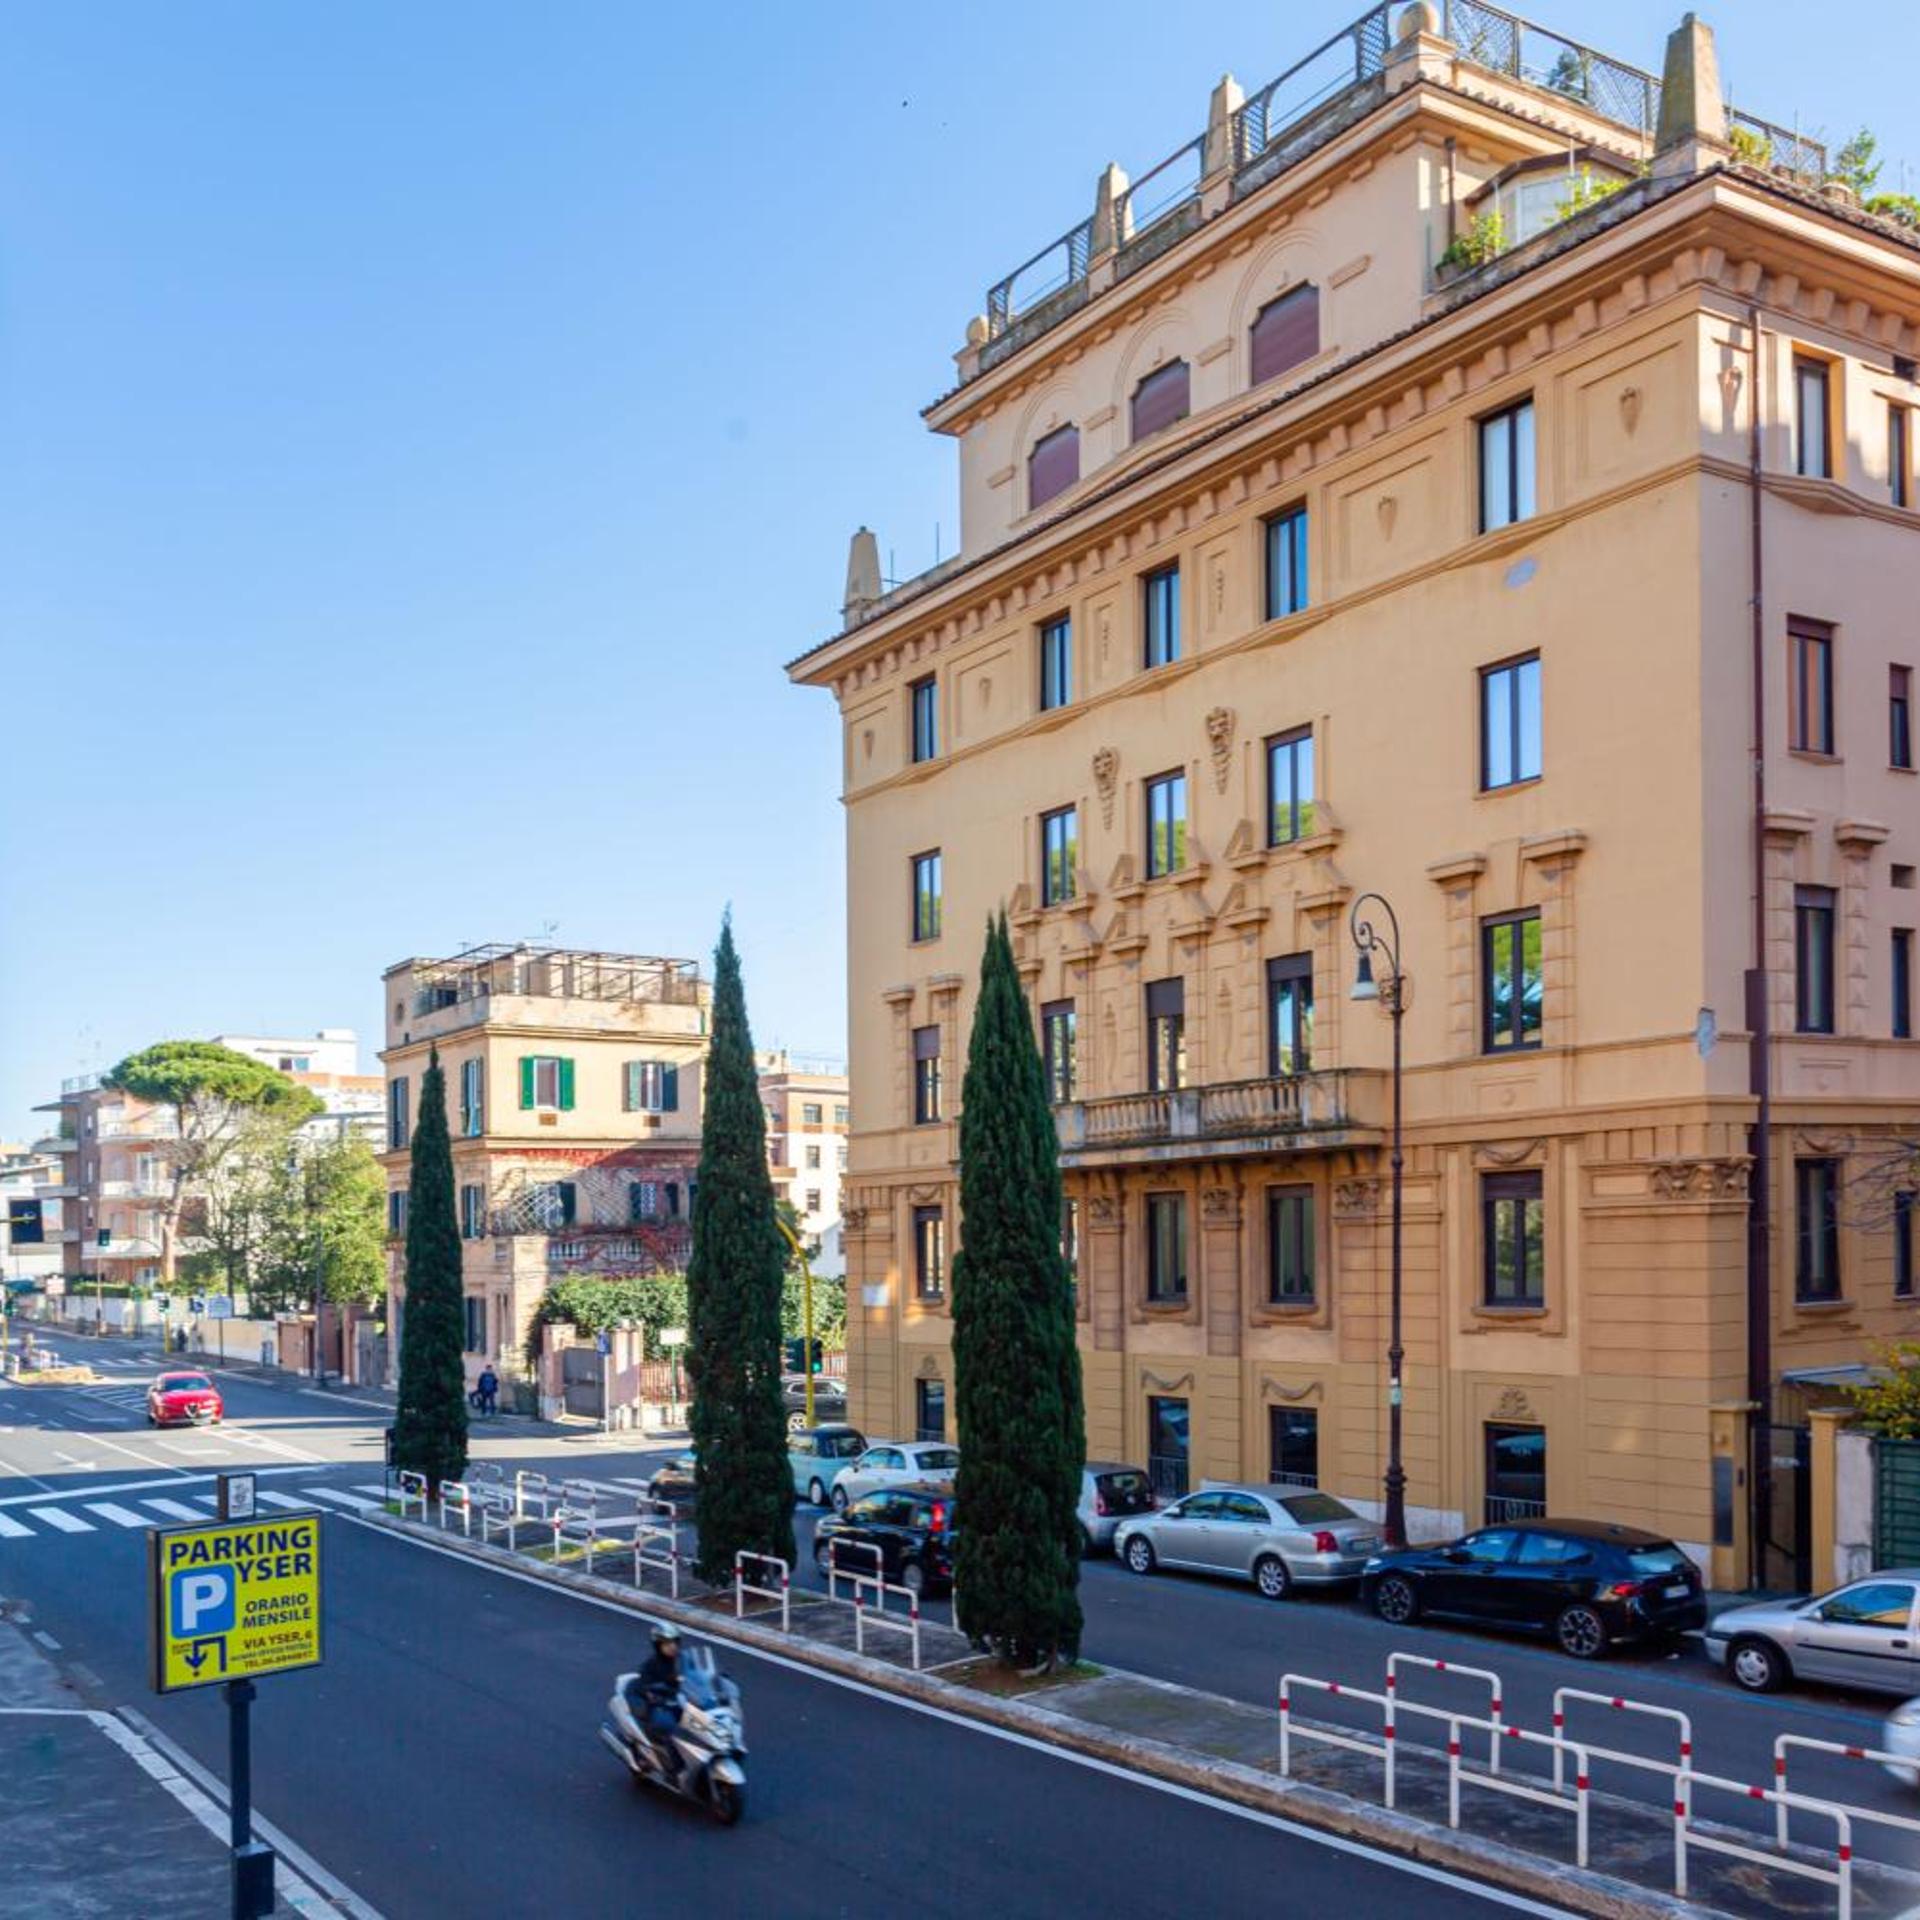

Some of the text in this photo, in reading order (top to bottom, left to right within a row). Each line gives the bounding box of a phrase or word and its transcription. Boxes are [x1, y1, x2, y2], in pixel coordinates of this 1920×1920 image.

[169, 1526, 312, 1567] PARKING
[236, 1552, 312, 1583] YSER
[181, 1574, 228, 1630] P
[245, 1593, 308, 1614] ORARIO
[242, 1607, 312, 1629] MENSILE
[243, 1636, 266, 1649] VIA
